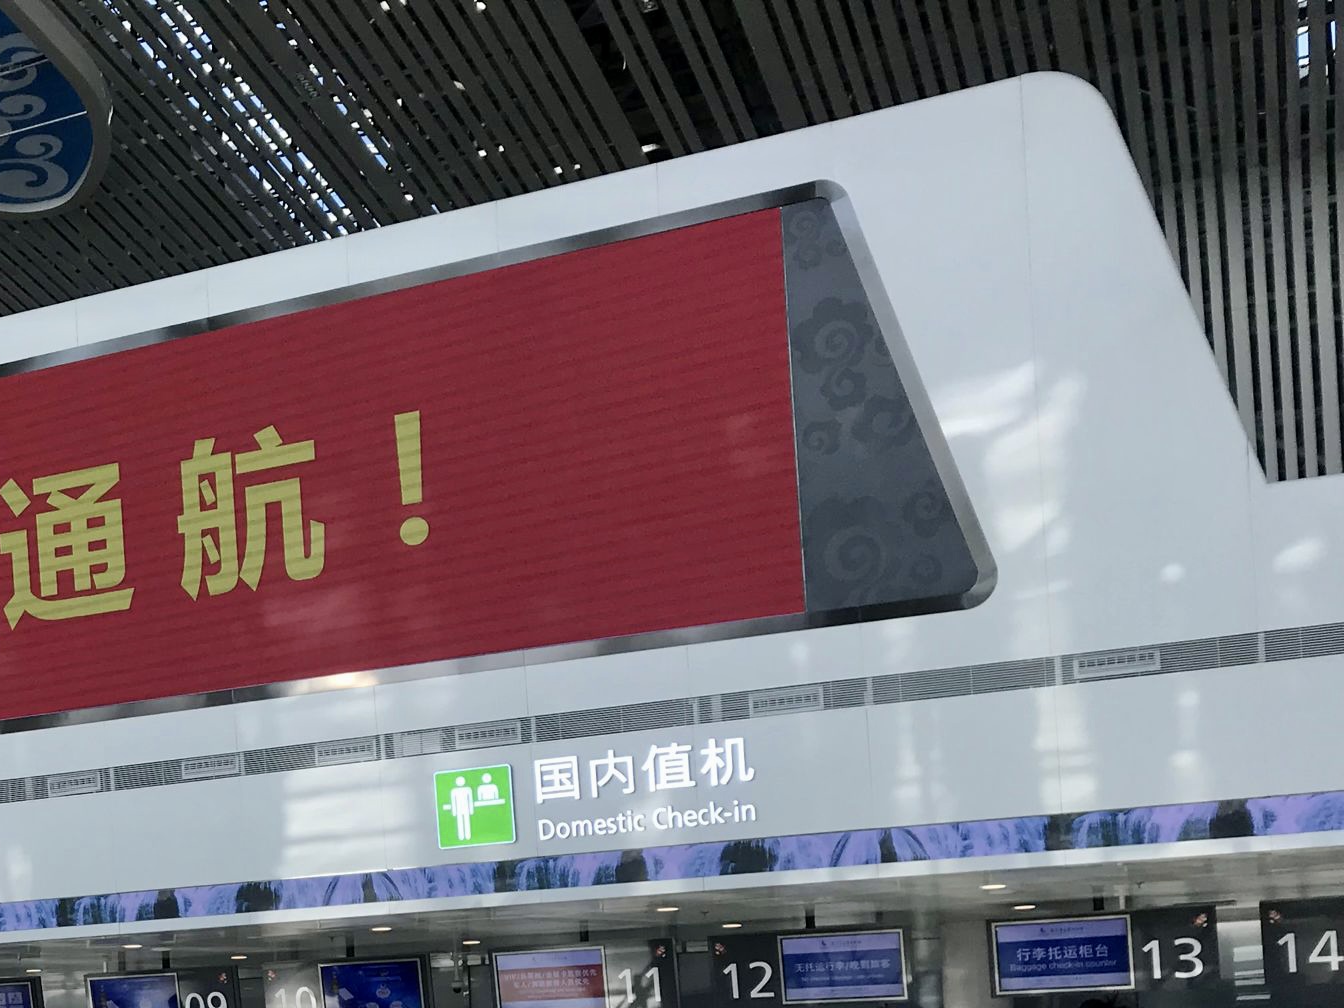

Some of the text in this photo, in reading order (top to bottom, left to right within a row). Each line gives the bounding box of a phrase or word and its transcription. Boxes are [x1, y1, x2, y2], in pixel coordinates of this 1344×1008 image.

[533, 735, 755, 803] 国内值机
[538, 799, 757, 841] Domestic Check-in
[1016, 943, 1109, 962] 行李托运柜台
[1141, 936, 1204, 980] 13
[1276, 929, 1344, 973] 14
[618, 967, 661, 1004] 11
[722, 961, 775, 1000] 12
